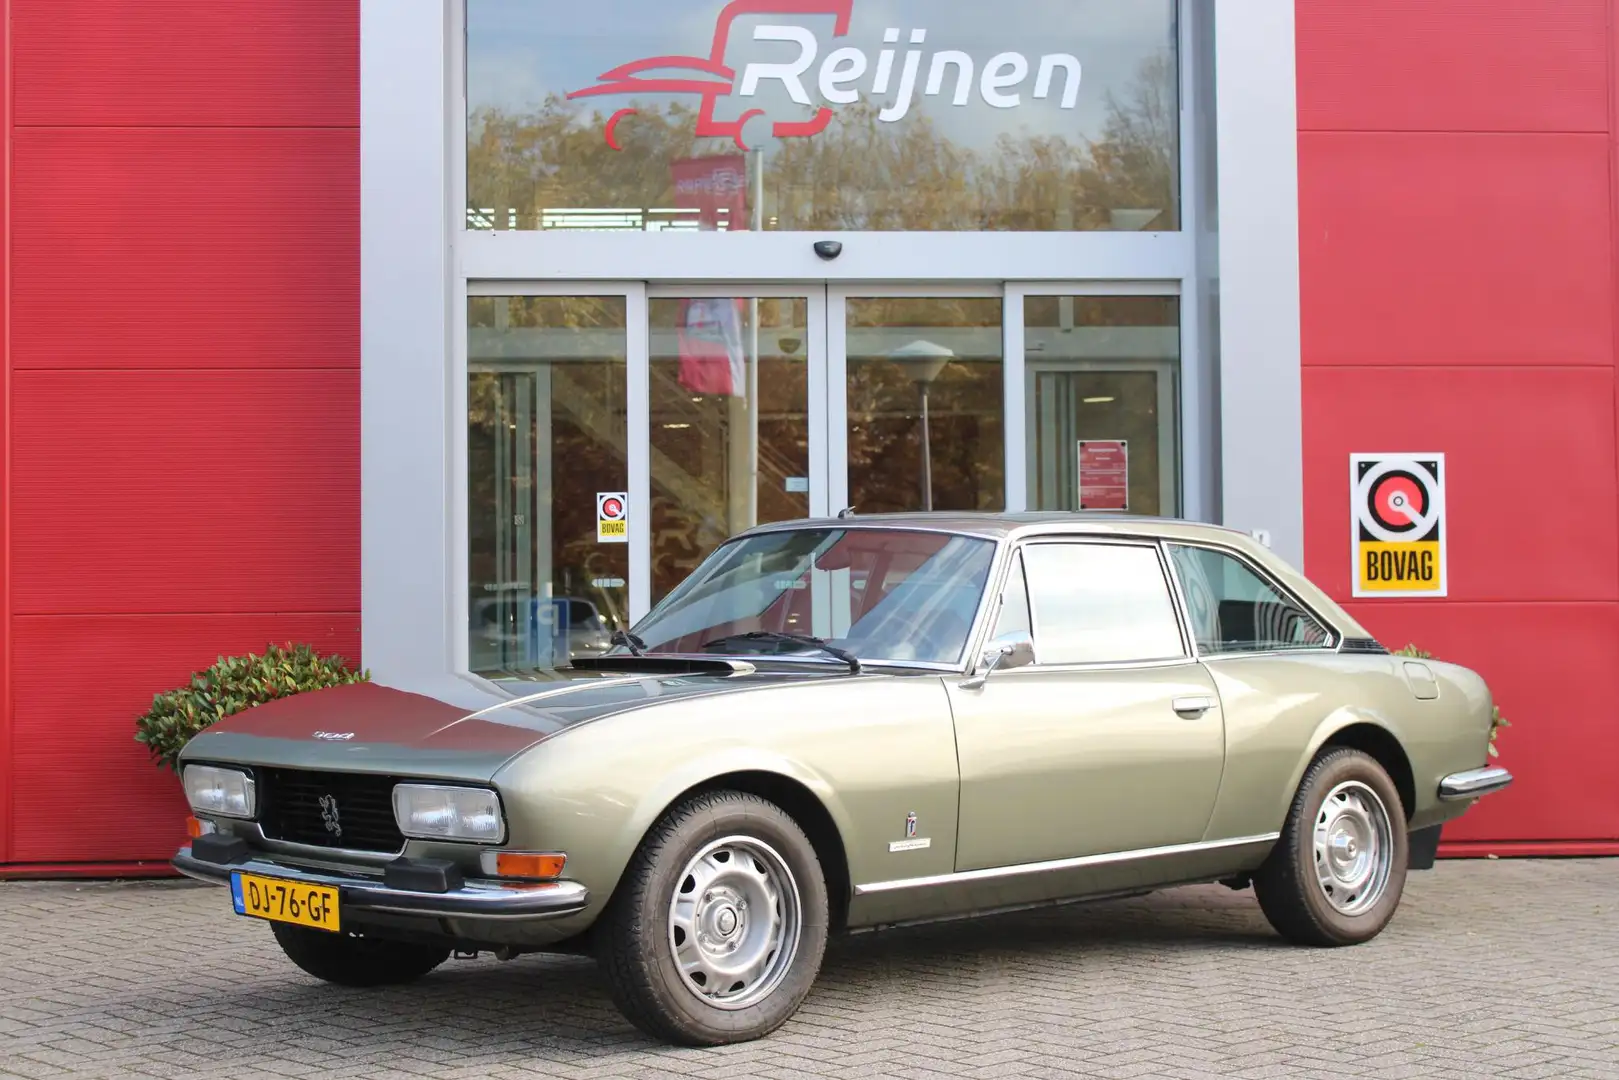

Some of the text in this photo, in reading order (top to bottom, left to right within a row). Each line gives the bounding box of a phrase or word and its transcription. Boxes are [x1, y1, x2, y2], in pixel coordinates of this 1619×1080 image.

[740, 25, 1082, 122] Reijnen
[601, 522, 625, 534] BOVAG
[1367, 550, 1433, 581] BOVAG
[249, 881, 331, 923] DJ-76-GF
